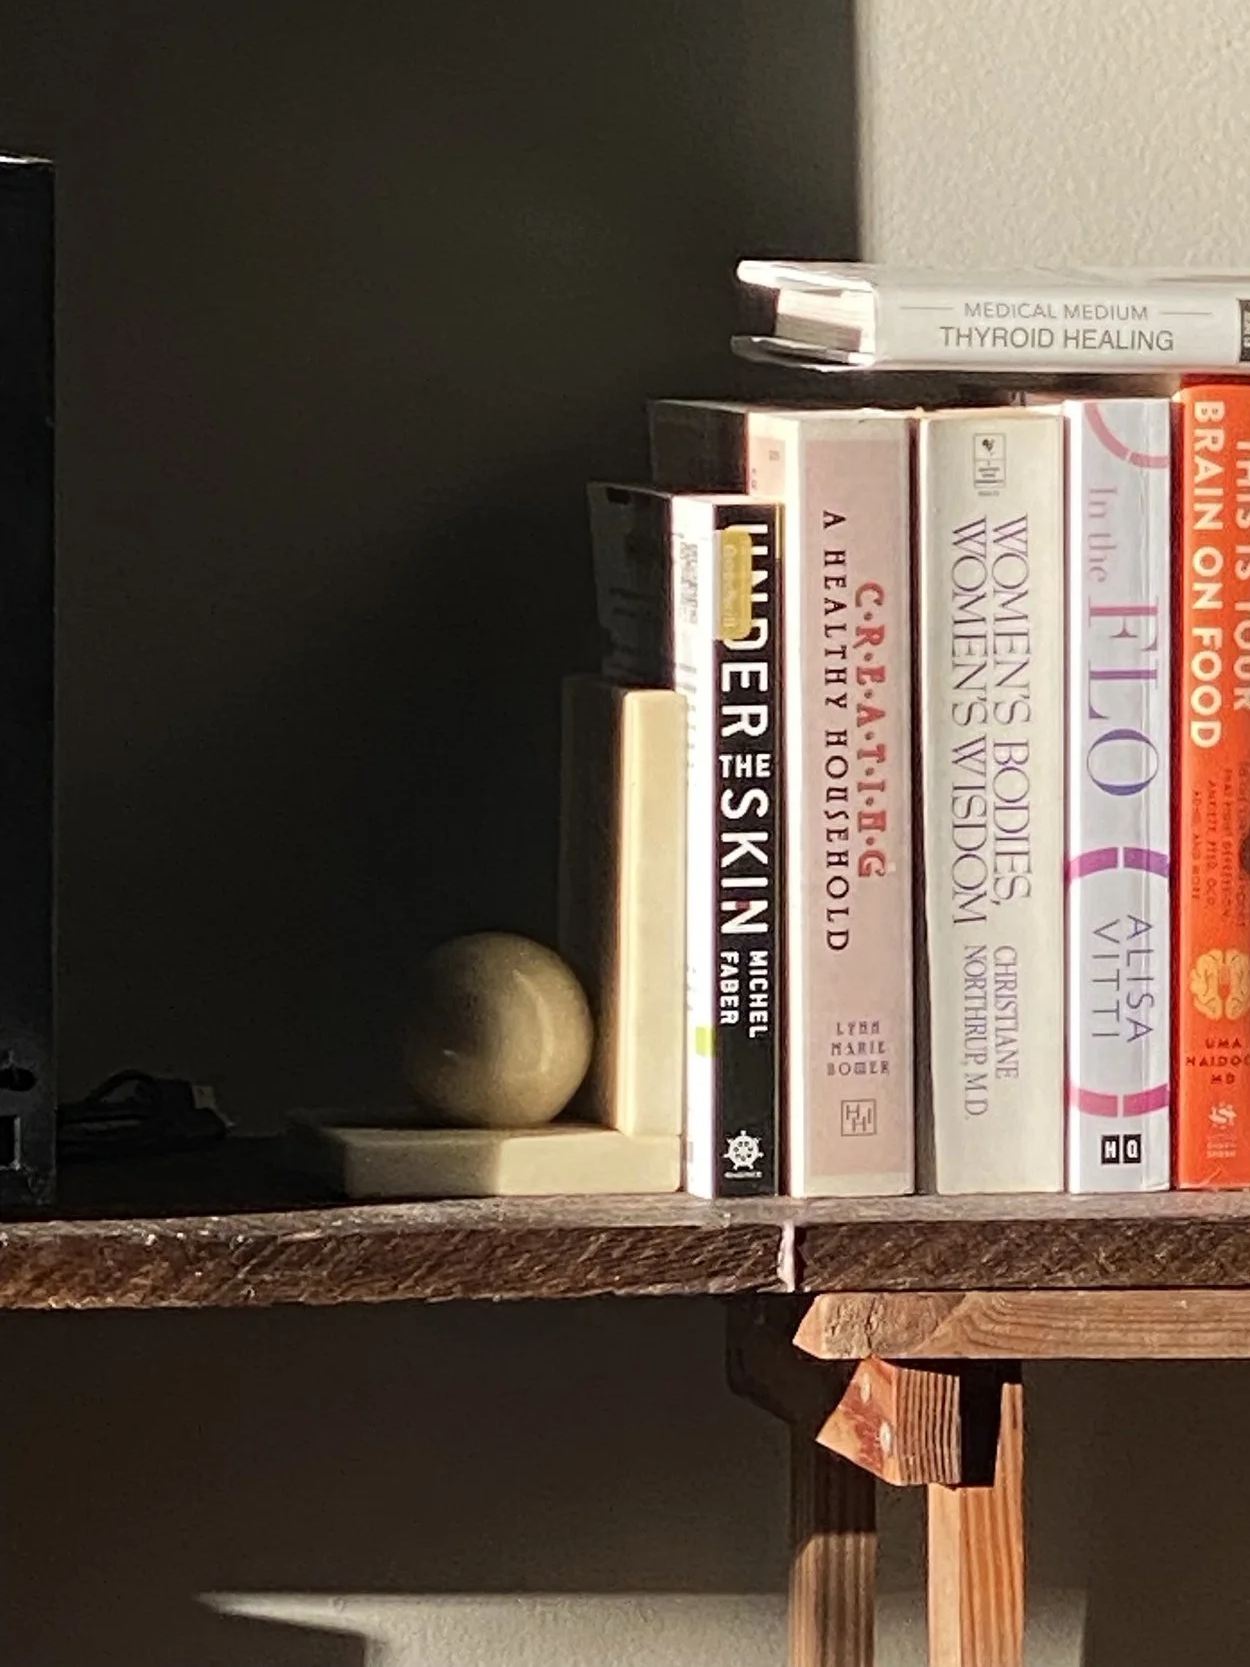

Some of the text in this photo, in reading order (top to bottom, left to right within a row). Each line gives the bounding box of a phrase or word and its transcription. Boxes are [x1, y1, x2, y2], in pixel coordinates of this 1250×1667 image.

[939, 325, 1174, 352] THYROID HEALING
[963, 301, 1149, 323] MEDICAL MEDIUM
[950, 514, 989, 728] WOMEN'S
[1086, 484, 1160, 796] In the FLO
[1190, 400, 1226, 749] BRAIN ON FOOD
[718, 753, 772, 778] THE
[822, 509, 850, 951] A HEALTHY HOUSEHOLD
[990, 512, 1032, 907] WOMEN'S BODIES,
[720, 788, 770, 934] SKIN
[950, 733, 989, 928] WISDOM
[719, 950, 740, 1025] FABER
[748, 950, 769, 1038] MICHEL
[961, 943, 990, 1121] NORTHRUP, M.D.
[993, 944, 1020, 1080] CHRISTIANE
[1091, 917, 1121, 1038] VITTI
[1126, 913, 1155, 1045] ALISA
[1205, 1038, 1243, 1049] UMA
